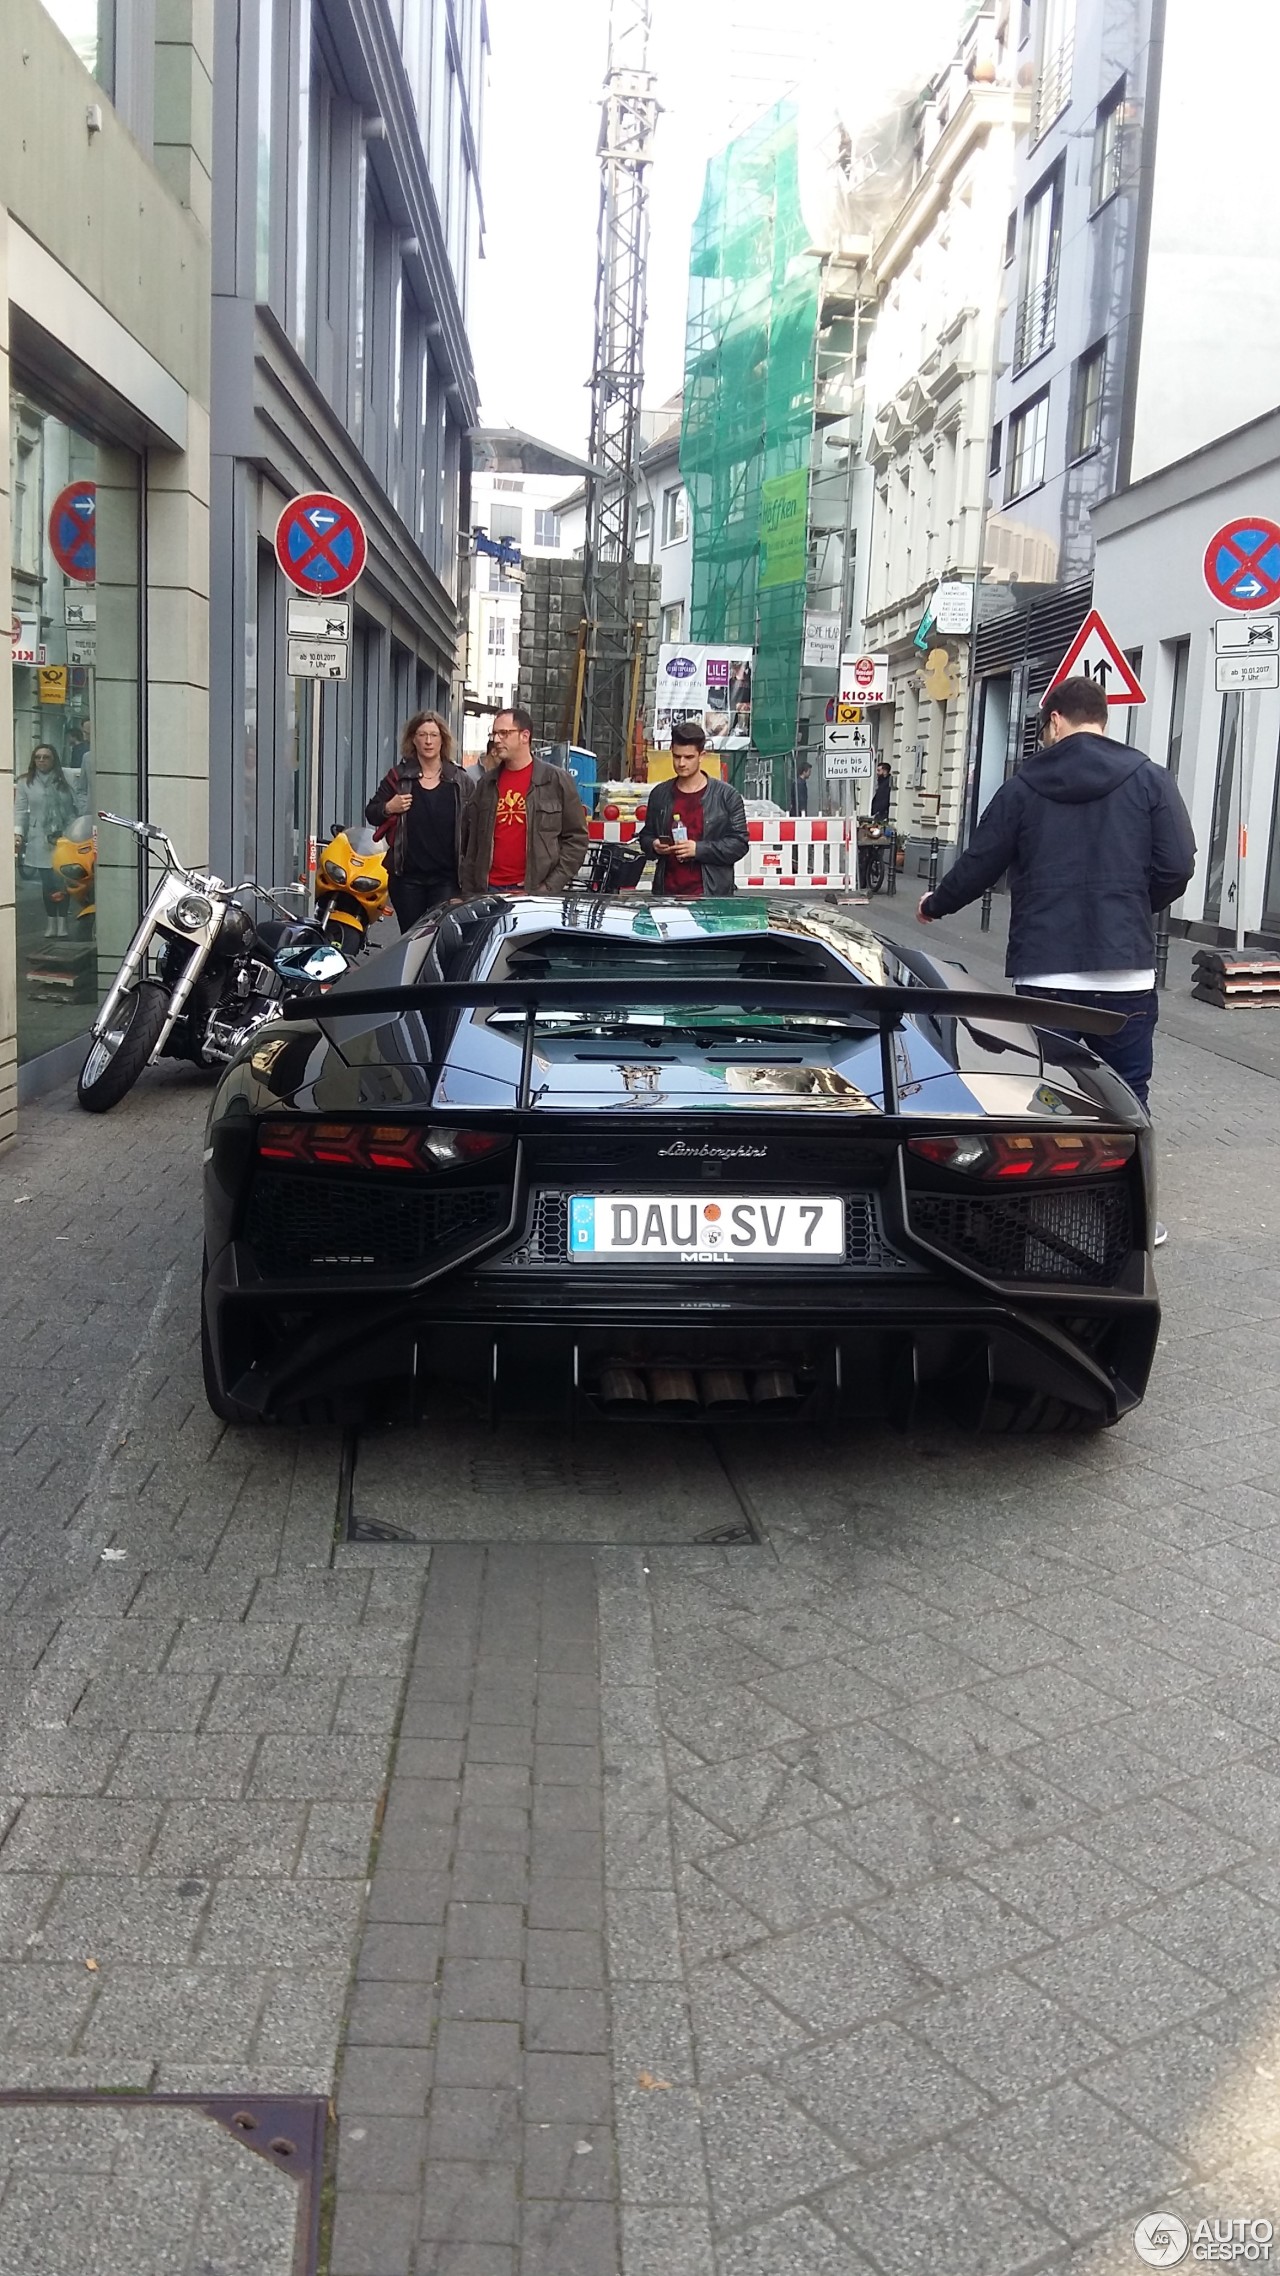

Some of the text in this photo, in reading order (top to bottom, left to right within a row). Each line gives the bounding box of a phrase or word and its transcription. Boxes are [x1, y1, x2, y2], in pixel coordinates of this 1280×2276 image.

[810, 641, 835, 650] Eingang
[707, 664, 727, 677] LILE
[1241, 666, 1269, 674] 10.01.2017
[842, 691, 884, 702] KIOSK
[833, 756, 863, 765] frei bis
[828, 767, 848, 775] Haus
[657, 1140, 769, 1161] Lamborghini
[610, 1204, 824, 1247] DAU SV 7
[577, 1229, 589, 1243] D
[680, 1252, 735, 1263] MOLL
